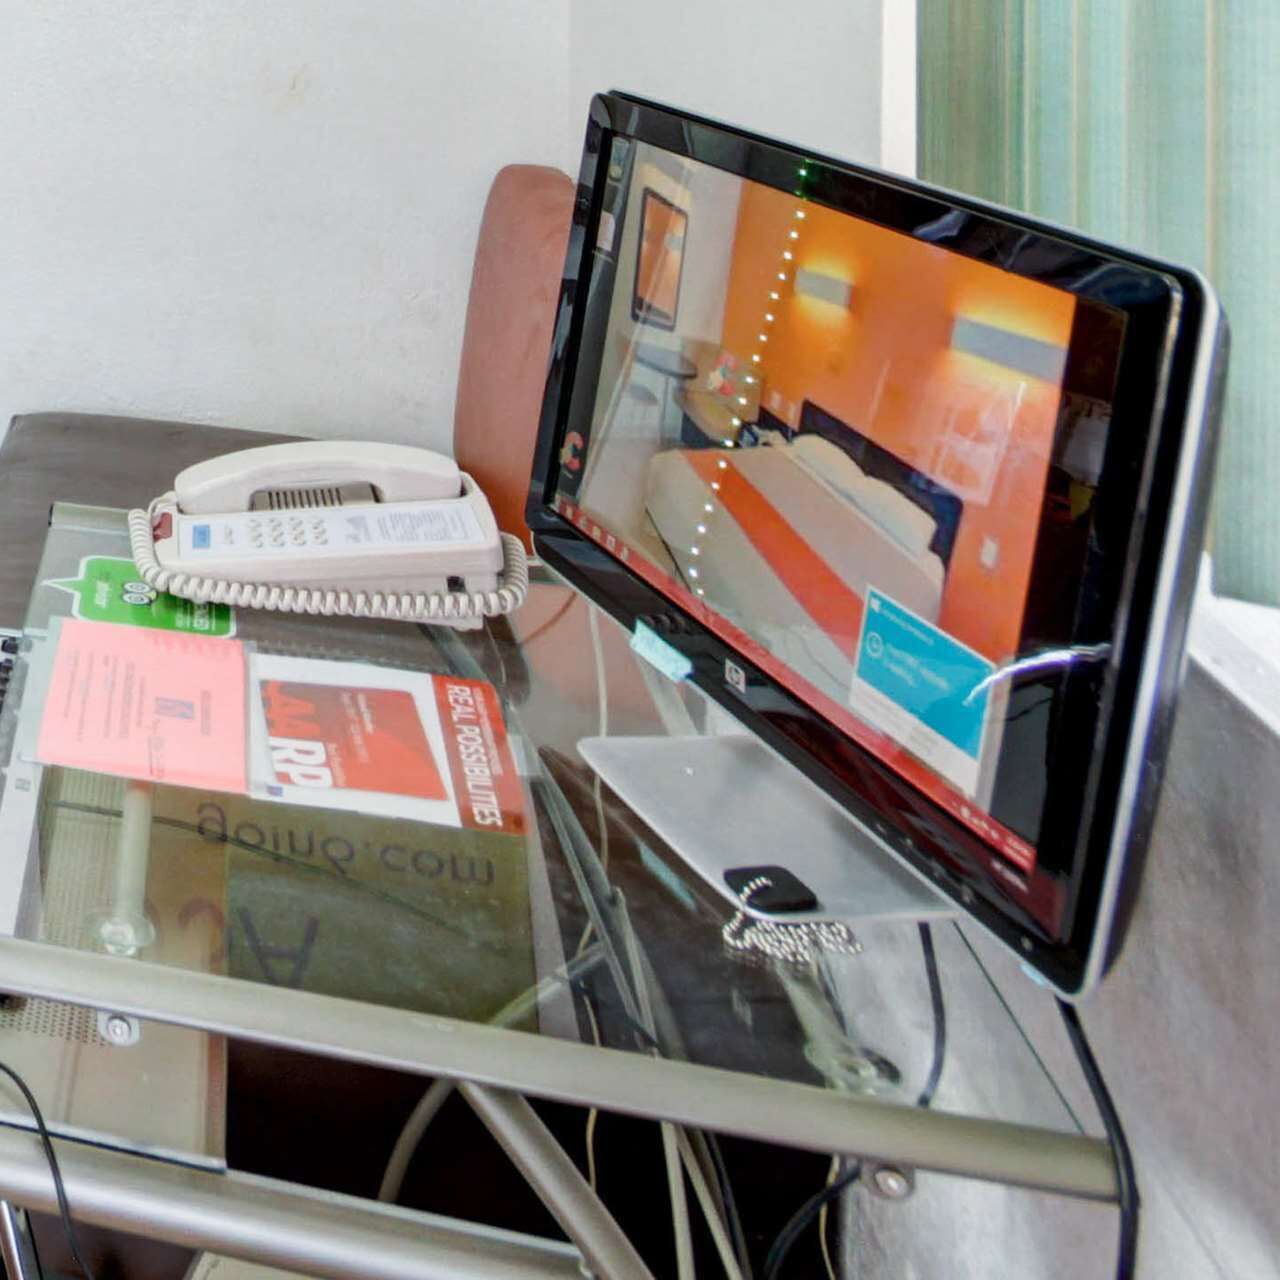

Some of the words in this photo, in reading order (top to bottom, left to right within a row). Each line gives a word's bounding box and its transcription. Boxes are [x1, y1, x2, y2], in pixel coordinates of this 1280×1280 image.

[260, 679, 334, 789] AARP
[446, 683, 476, 722] REAL
[455, 721, 504, 828] POSSIBILITIES
